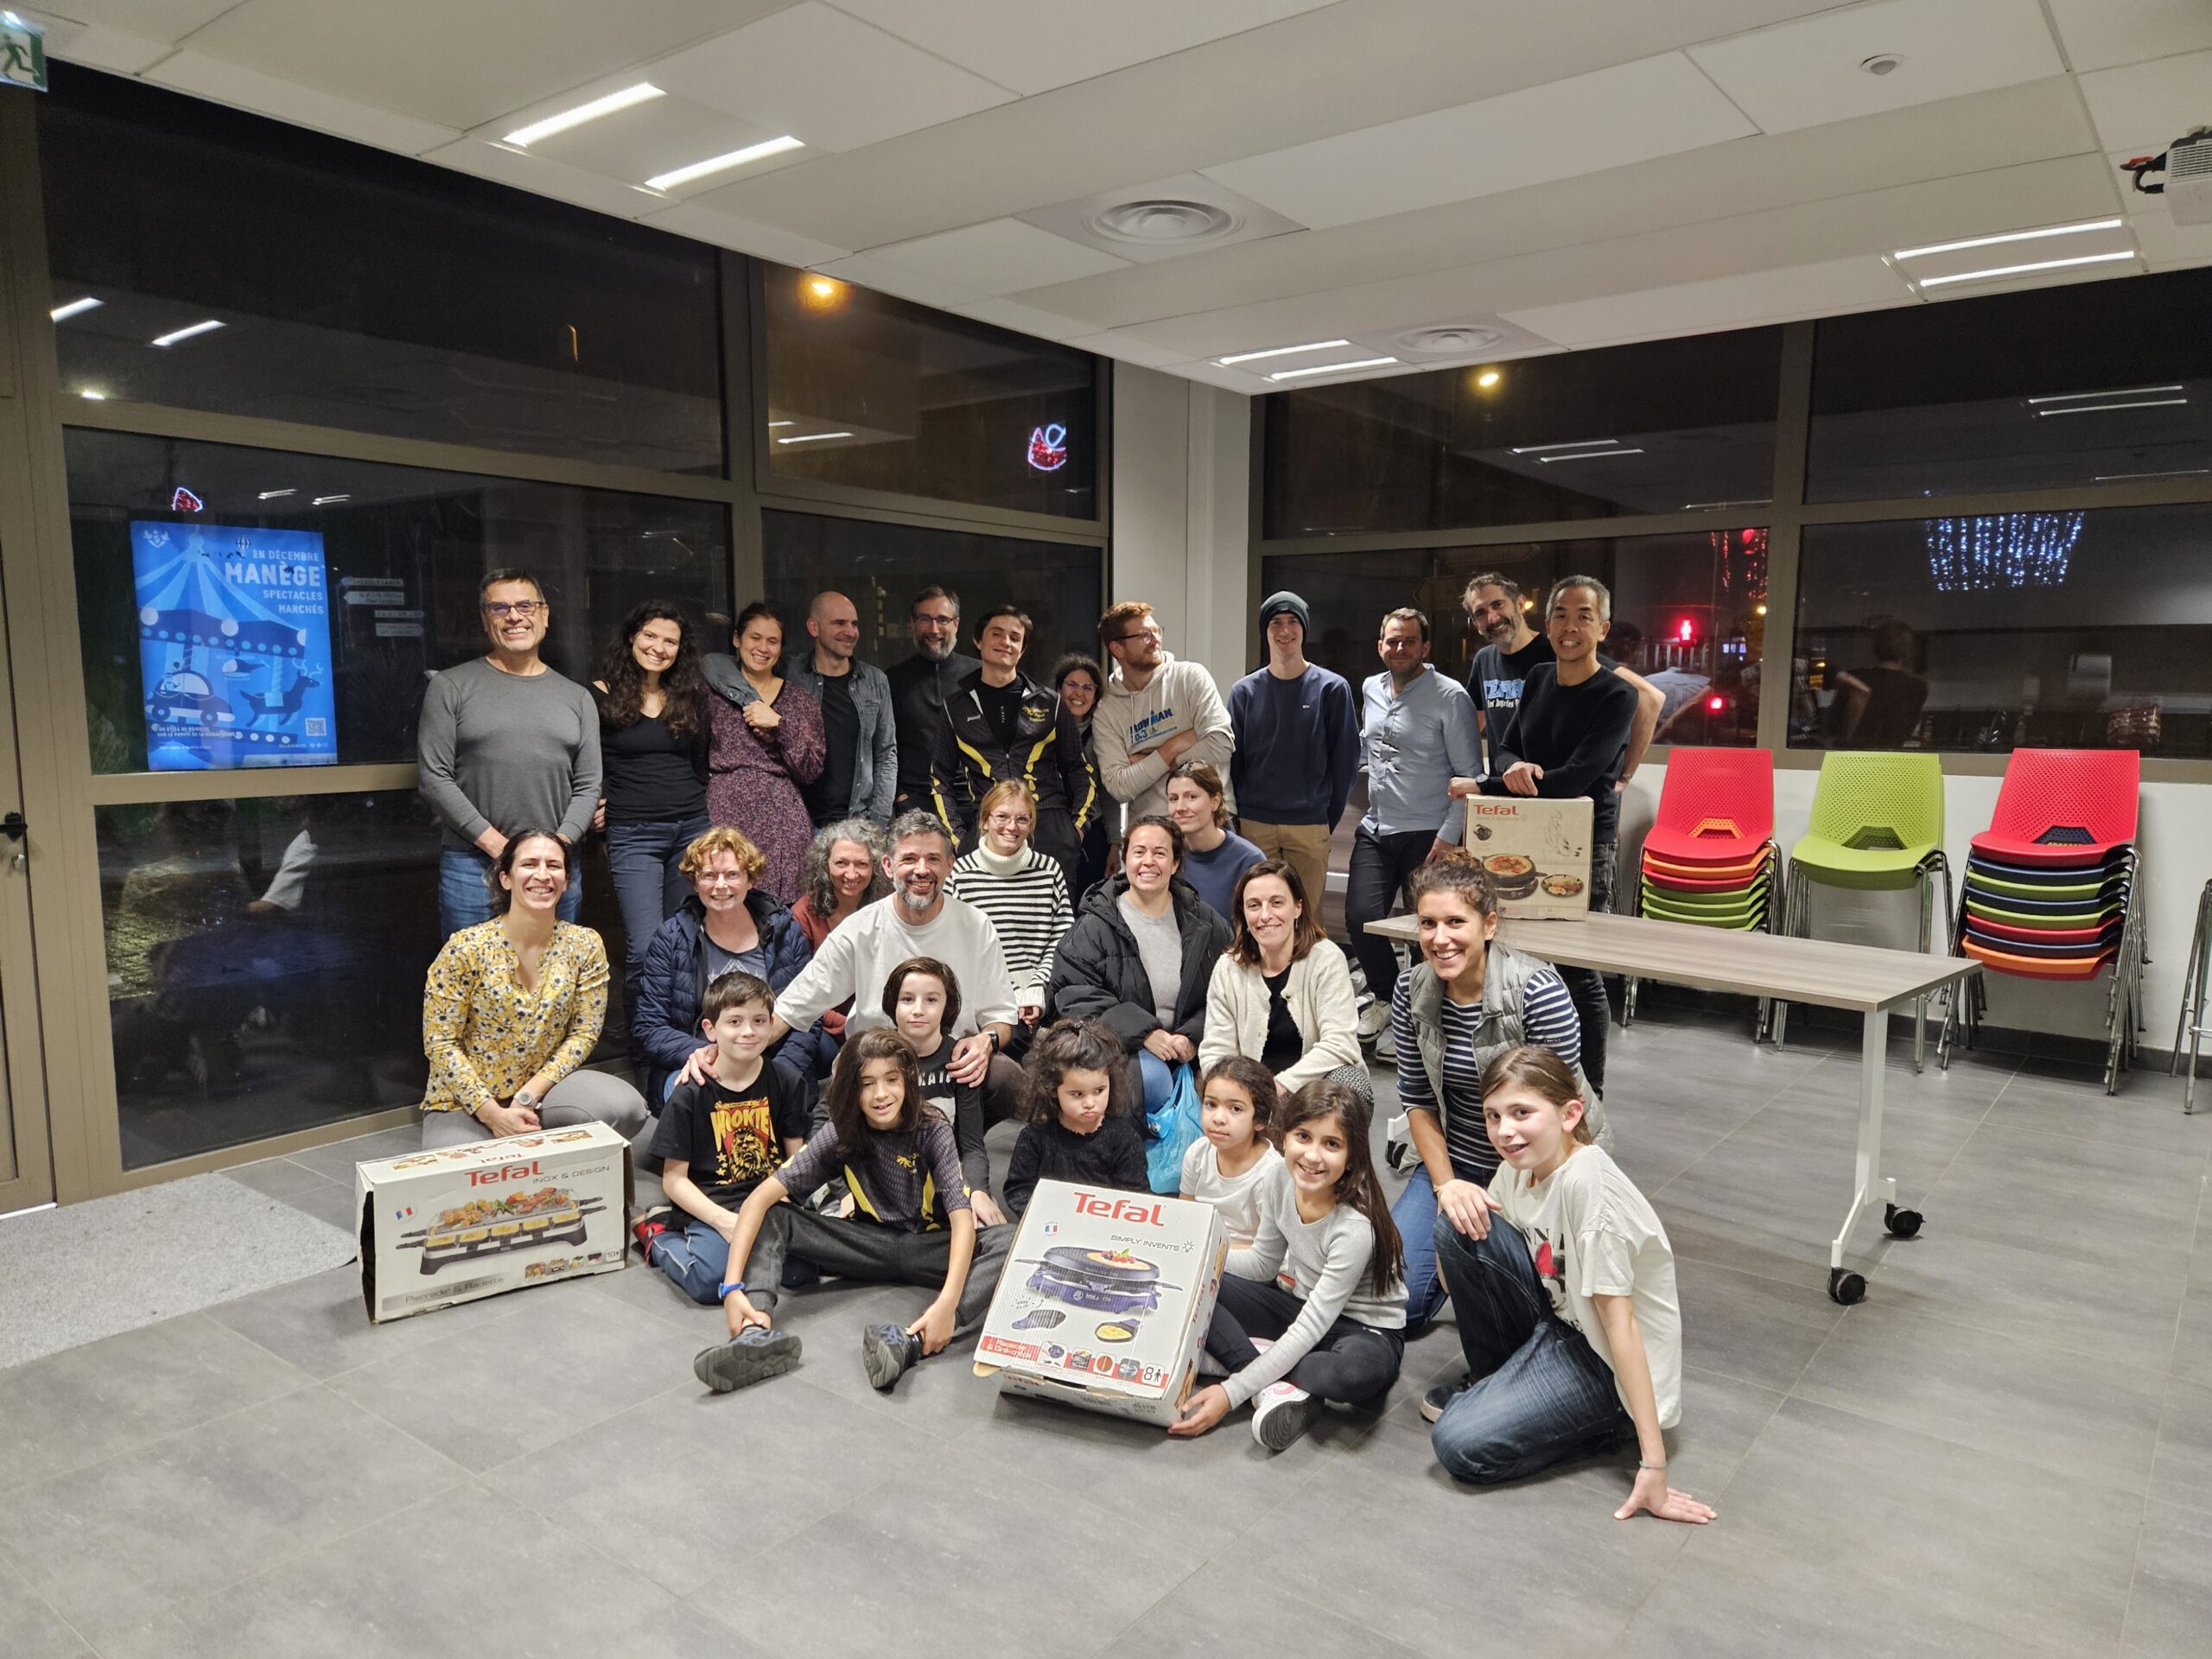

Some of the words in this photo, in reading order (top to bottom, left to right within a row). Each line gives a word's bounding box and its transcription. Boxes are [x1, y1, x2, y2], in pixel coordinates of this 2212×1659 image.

[252, 549, 265, 560] EN
[269, 549, 320, 562] DÉCEMBRE
[225, 560, 321, 587] MANÈGE
[263, 589, 323, 601] SPECTACLES
[278, 603, 324, 614] MARCHÉS
[1473, 804, 1520, 816] Tefal
[464, 1160, 544, 1187] Tefal
[532, 1174, 558, 1185] INOX
[572, 1165, 611, 1178] DESIGN
[1073, 1192, 1165, 1227] Tefal
[1110, 1234, 1141, 1245] SIMPLY
[1142, 1240, 1180, 1252] INVENTS
[1143, 1366, 1154, 1381] 8
